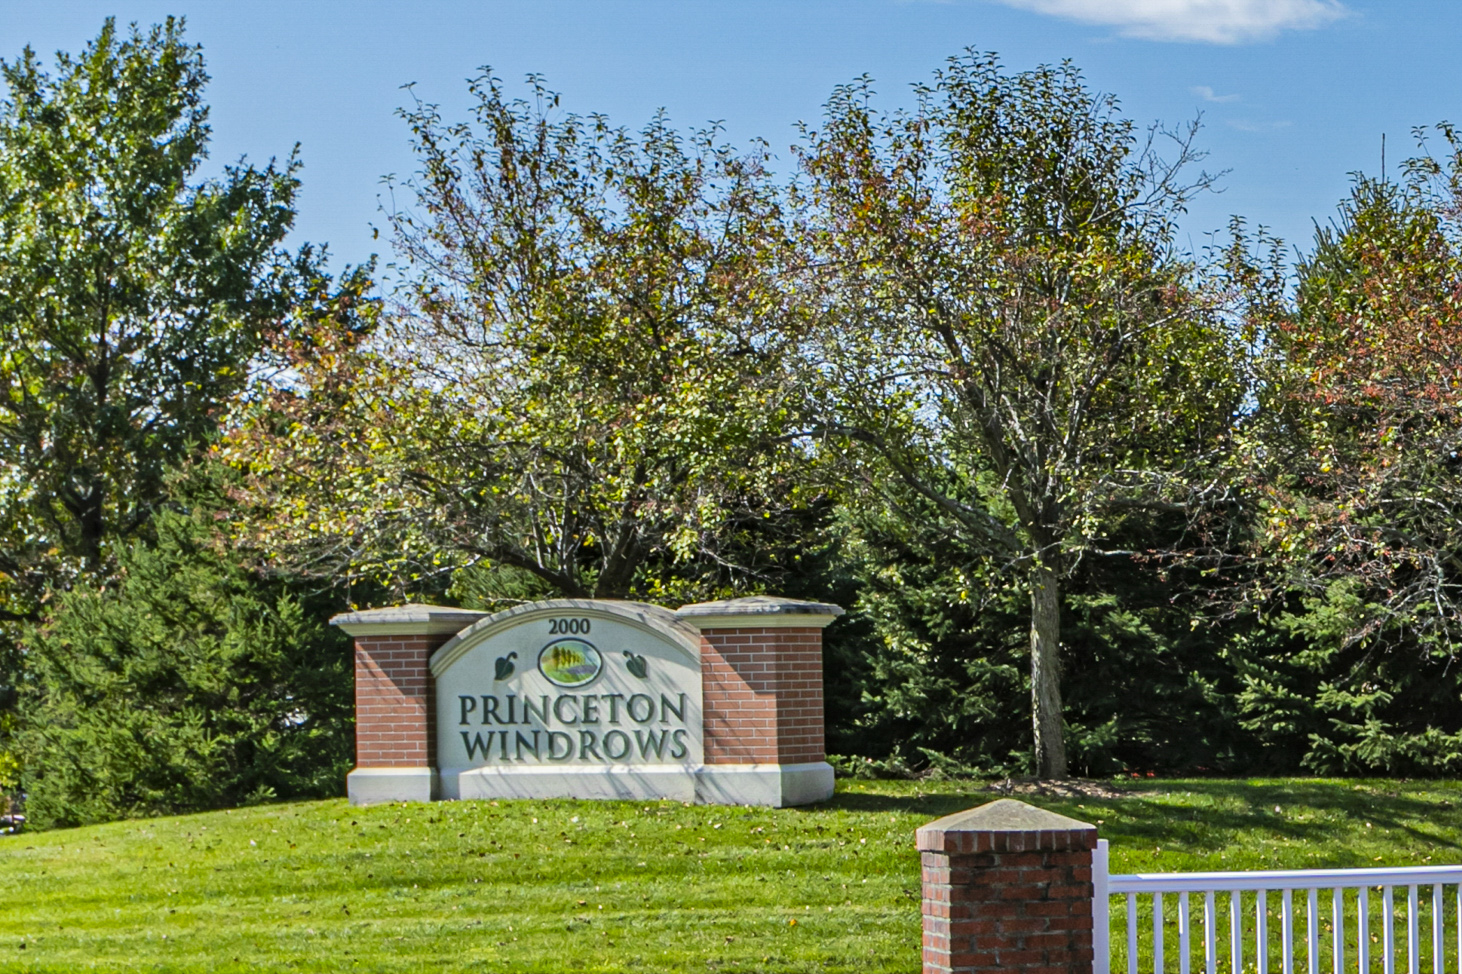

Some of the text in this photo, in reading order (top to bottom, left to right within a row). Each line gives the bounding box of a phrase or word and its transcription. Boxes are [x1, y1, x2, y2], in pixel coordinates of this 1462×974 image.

[548, 618, 591, 635] 2000
[458, 693, 686, 725] PRINCETON
[459, 729, 689, 761] WINDROWS
